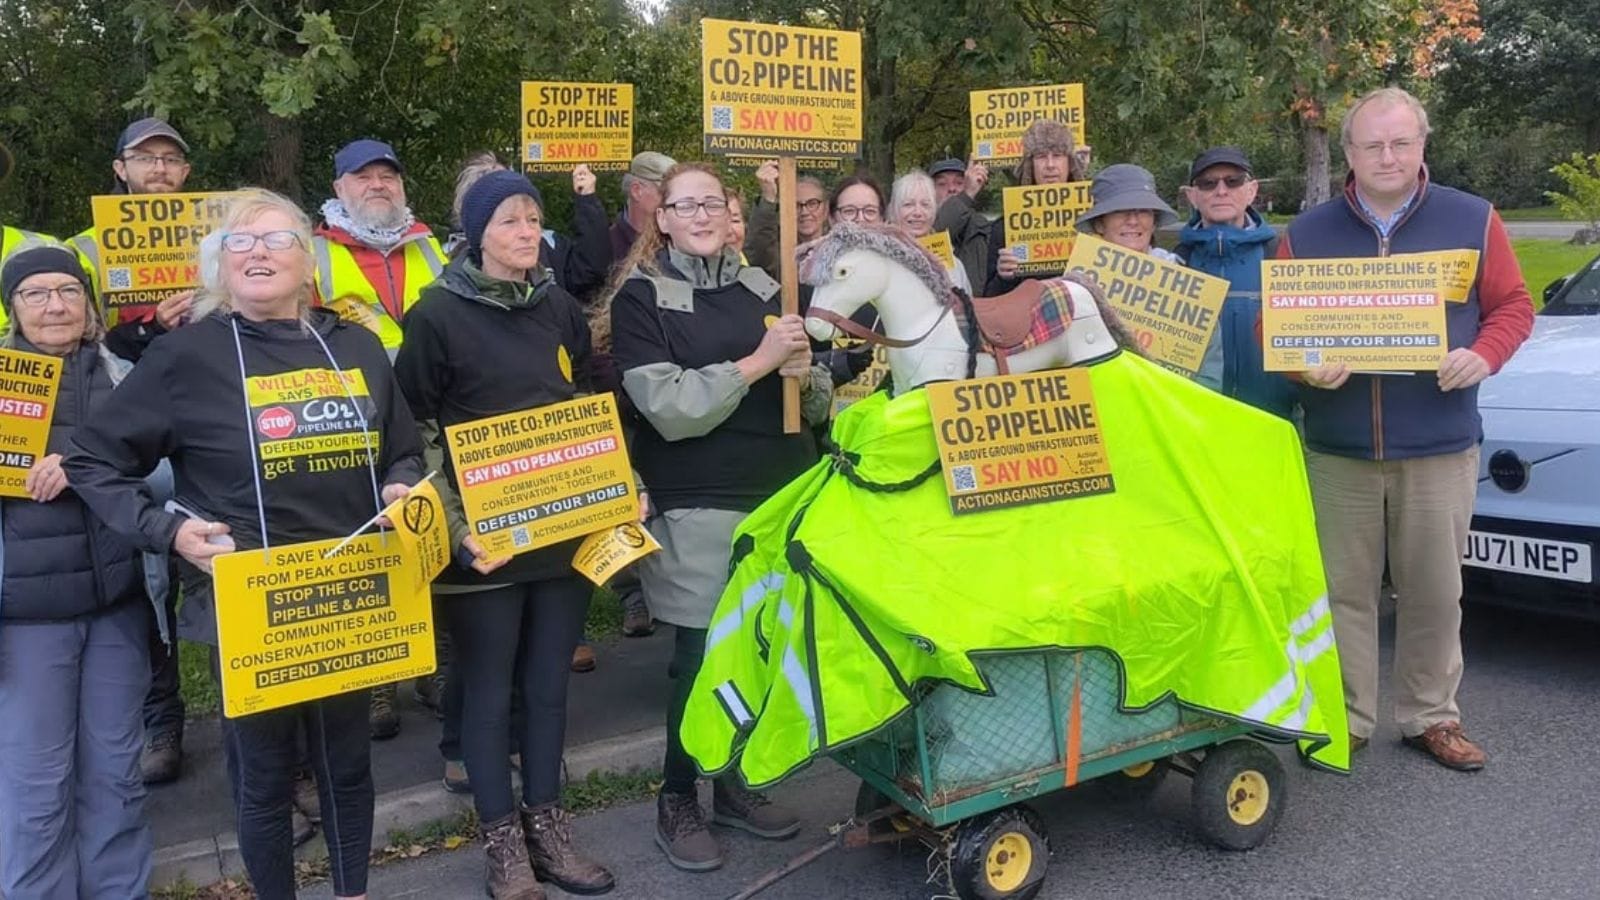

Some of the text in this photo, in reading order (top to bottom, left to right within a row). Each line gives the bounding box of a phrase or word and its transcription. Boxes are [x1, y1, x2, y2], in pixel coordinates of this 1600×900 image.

[728, 28, 839, 62] STOP THE
[754, 62, 856, 94] PIPELINE
[540, 86, 618, 106] STOP THE
[711, 91, 856, 110] & ABOVE GROUND INFRASTRUCTURE
[987, 88, 1067, 111] STOP THE
[558, 110, 629, 128] PIPELINE
[739, 108, 812, 133] SAY NO
[547, 143, 575, 159] SAY
[578, 143, 599, 159] NO
[710, 137, 858, 153] ACTIONAGAINSTCCS.COM
[995, 139, 1024, 155] SAY
[1023, 188, 1070, 209] STOP
[119, 199, 184, 223] STOP
[116, 254, 146, 264] ABOVE
[148, 252, 185, 263] GROUND
[1033, 241, 1064, 259] SAY
[138, 266, 178, 286] SAY
[1093, 246, 1155, 281] STOP
[1159, 266, 1206, 300] THE
[1271, 264, 1305, 278] STOP
[1309, 264, 1335, 277] THE
[1362, 262, 1424, 277] PIPELINE
[1427, 262, 1438, 275] &
[1269, 281, 1301, 292] ABOVE
[1303, 280, 1346, 291] GROUND
[1348, 278, 1437, 290] INFRASTRUCTURE
[1107, 278, 1215, 332] PIPELINE
[1272, 294, 1435, 307] SAY NO TO PEAK CLUSTER
[1133, 313, 1205, 346] INFRASTRUCTURE
[1281, 321, 1430, 331] CONSERVATION TOGETHER
[1305, 313, 1404, 322] COMMUNITIES AND
[1273, 336, 1437, 347] DEFEND YOUR HOME
[1326, 354, 1441, 364] ACTIONAGAINSTCCS.COM
[43, 363, 54, 380] &
[278, 388, 313, 401] SAYS
[954, 376, 1071, 413] STOP THE
[261, 416, 292, 430] STOP
[297, 421, 344, 434] PIPELINE
[345, 420, 352, 429] &
[455, 427, 490, 447] STOP
[492, 421, 519, 439] THE
[544, 404, 600, 428] PIPELINE
[601, 400, 611, 414] &
[986, 404, 1096, 441] PIPELINE
[263, 440, 315, 455] DEFEND
[317, 436, 349, 449] YOUR
[459, 420, 614, 465] ABOVE GROUND INFRASTRUCTURE
[948, 434, 1100, 462] & ABOVE GROUND INFRASTRUCTURE
[263, 457, 297, 480] get
[465, 438, 616, 485] SAY NO TO PEAK CLUSTER
[980, 454, 1059, 487] SAY NO
[481, 470, 617, 512] CONSERVATION TOGETHER
[503, 465, 593, 495] COMMUNITIES AND
[957, 478, 1110, 510] ACTIONAGAINSTCCS.COM
[478, 485, 627, 533] DEFEND YOUR HOME
[532, 505, 633, 539] ACTIONAGAINSTCCS.COM
[276, 542, 374, 567] SAVE WIRRAL
[1523, 542, 1579, 576] NEP
[247, 571, 291, 590] FROM
[295, 563, 335, 582] PEAK
[338, 555, 402, 574] CLUSTER
[274, 588, 313, 606] STOP
[317, 582, 346, 598] THE
[272, 602, 338, 624] PIPELINE
[342, 598, 352, 610] &
[263, 609, 397, 646] COMMUNITIES AND
[230, 636, 346, 671] CONSERVATION
[258, 644, 409, 687] DEFEND YOUR HOME
[339, 664, 434, 691] ACTIONAGAINSTCCS.COM
